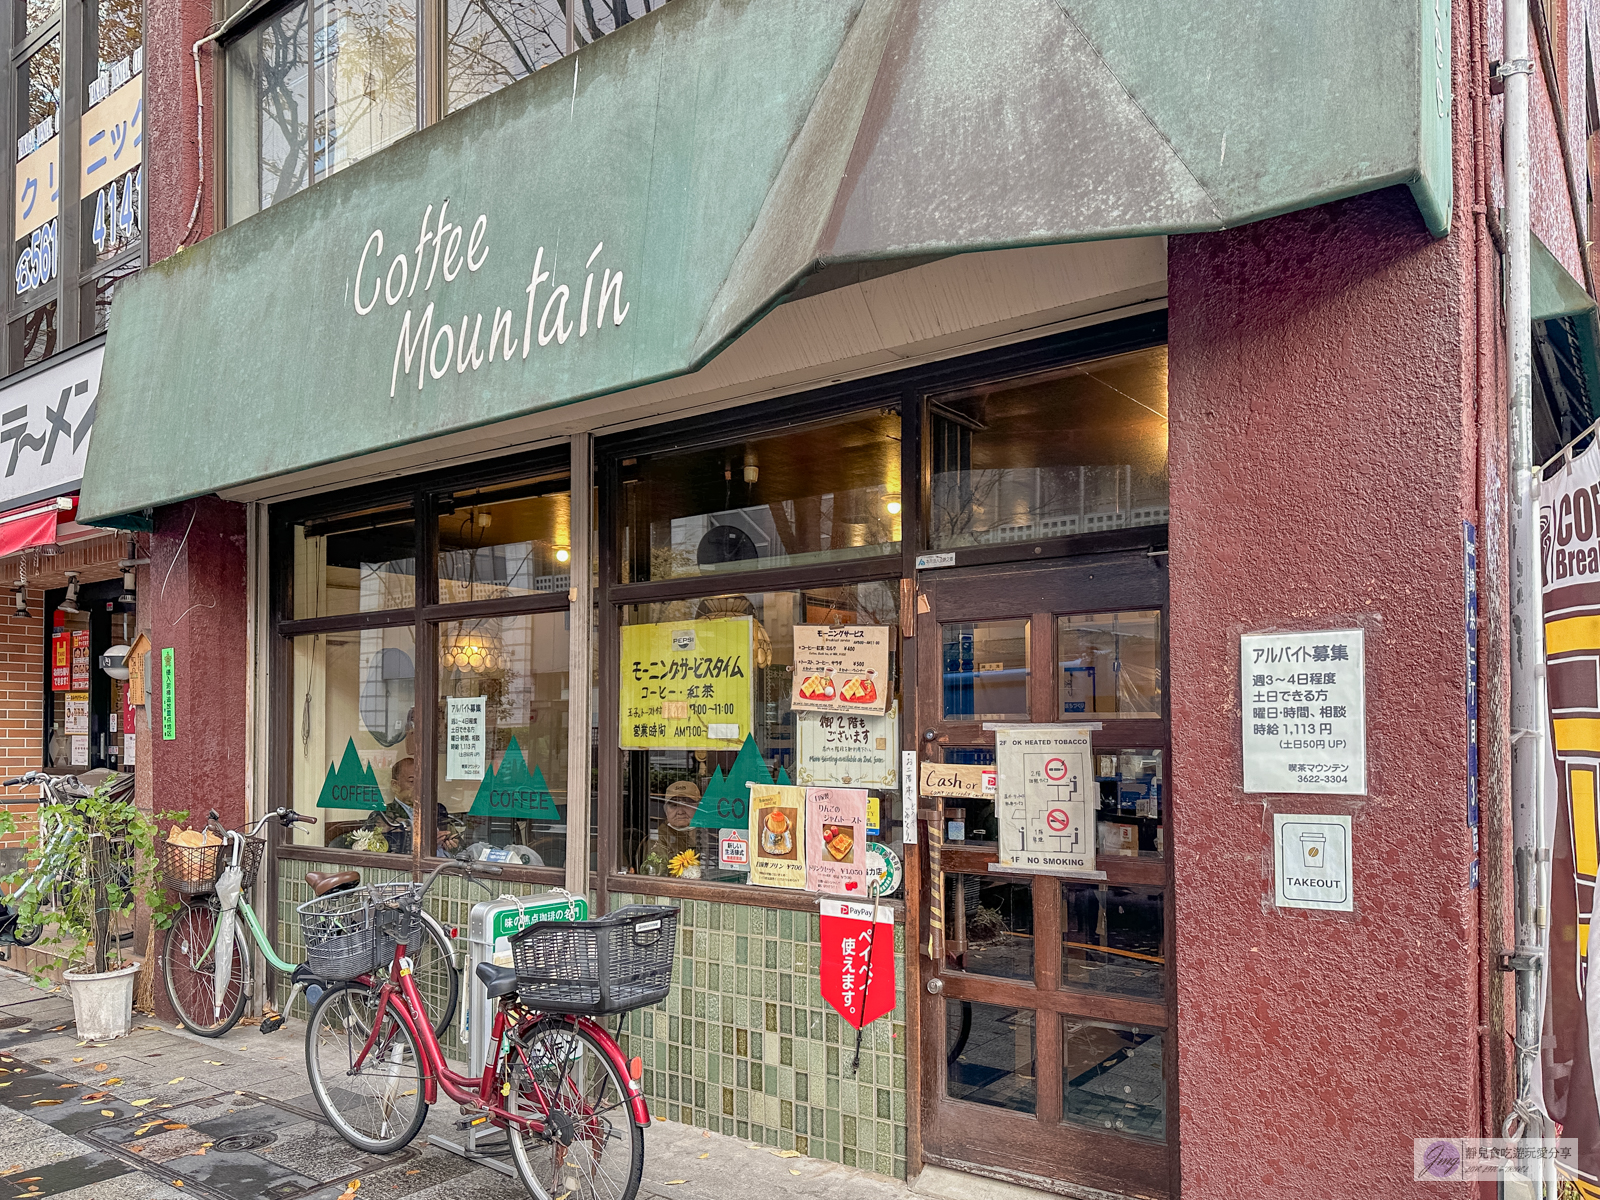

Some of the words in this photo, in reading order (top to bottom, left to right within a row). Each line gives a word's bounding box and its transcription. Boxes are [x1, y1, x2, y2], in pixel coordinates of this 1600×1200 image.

[354, 199, 489, 316] Coffee
[390, 242, 630, 398] Mountain
[1556, 543, 1600, 580] Brea
[1253, 644, 1348, 663] アルバイト募集
[632, 656, 744, 681] モーニングサービスタイム
[1253, 689, 1328, 702] 土日できる方
[451, 704, 481, 713] アルバイト募集
[826, 729, 870, 744] ございます
[1254, 724, 1279, 735] 時給
[1283, 724, 1316, 735] 1,113
[1320, 723, 1332, 735] 円
[1288, 764, 1349, 772] 喫茶マウンテン
[926, 770, 962, 788] Cash
[1298, 775, 1348, 783] 3622-3304
[332, 785, 378, 802] COFFEE
[490, 789, 549, 810] COFFEE
[824, 815, 862, 824] ジャムトースト
[1042, 858, 1084, 866] SMOKING
[1286, 878, 1340, 889] TAKEOUT
[850, 906, 872, 917] PayPay
[859, 929, 874, 996] ペイペイ
[841, 938, 856, 1014] 使えます。
